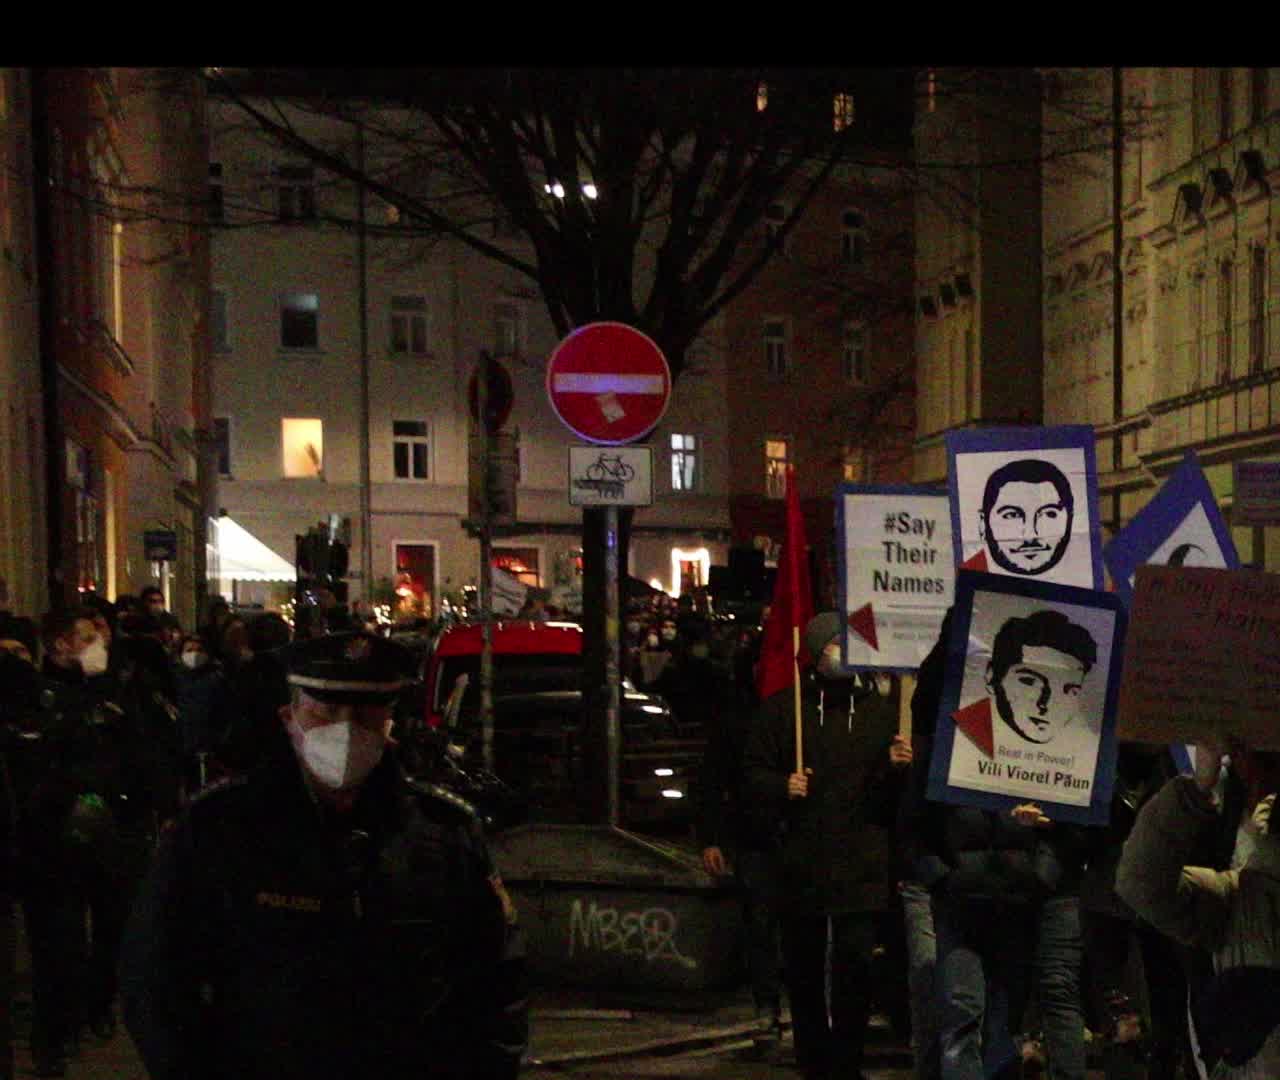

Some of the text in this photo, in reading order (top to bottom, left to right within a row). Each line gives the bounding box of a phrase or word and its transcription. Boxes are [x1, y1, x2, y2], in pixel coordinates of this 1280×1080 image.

[884, 512, 937, 540] #Say
[881, 541, 938, 565] Their
[873, 569, 945, 594] Names
[978, 760, 1002, 776] Vili
[1007, 765, 1050, 785] Viorel
